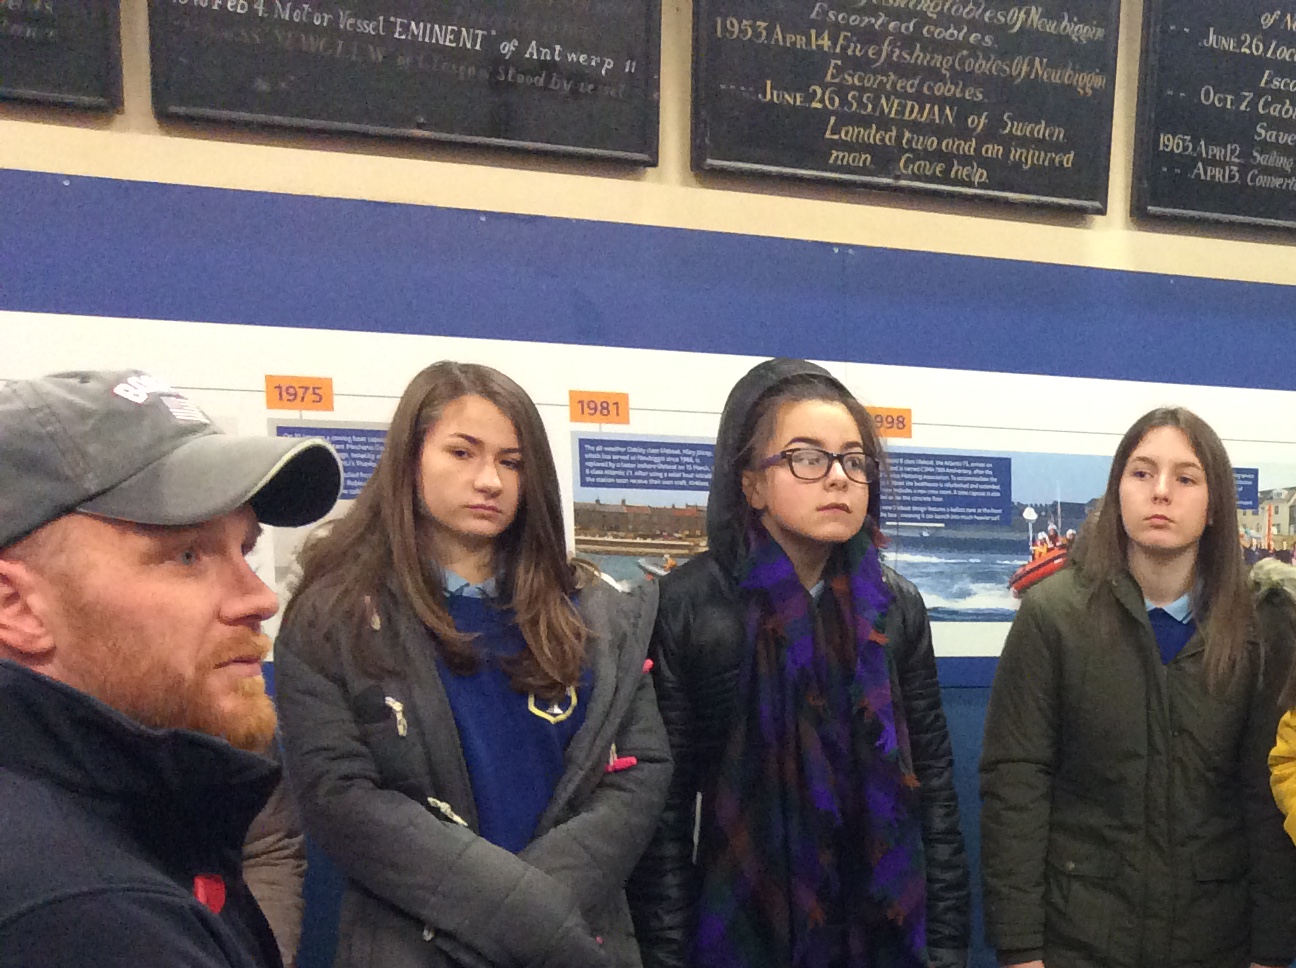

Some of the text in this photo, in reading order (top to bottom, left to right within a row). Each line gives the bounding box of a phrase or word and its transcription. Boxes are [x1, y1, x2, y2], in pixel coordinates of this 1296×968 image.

[809, 2, 918, 36] Escorted
[1028, 6, 1105, 45] Newbiggin
[1261, 10, 1281, 29] of
[273, 0, 333, 27] Motor
[338, 11, 385, 36] Vessel
[500, 39, 518, 59] of
[524, 40, 613, 75] Antwerp
[824, 58, 920, 93] Escorted
[834, 30, 878, 58] Five
[1031, 56, 1106, 97] Newbiggin
[968, 111, 989, 135] of
[824, 116, 1075, 170] Landed two and an injured
[828, 150, 872, 167] man
[900, 153, 946, 177] Gave
[1251, 147, 1292, 173] Sailing
[274, 383, 323, 404] 1975
[577, 399, 620, 418] 1981
[873, 414, 907, 431] 998
